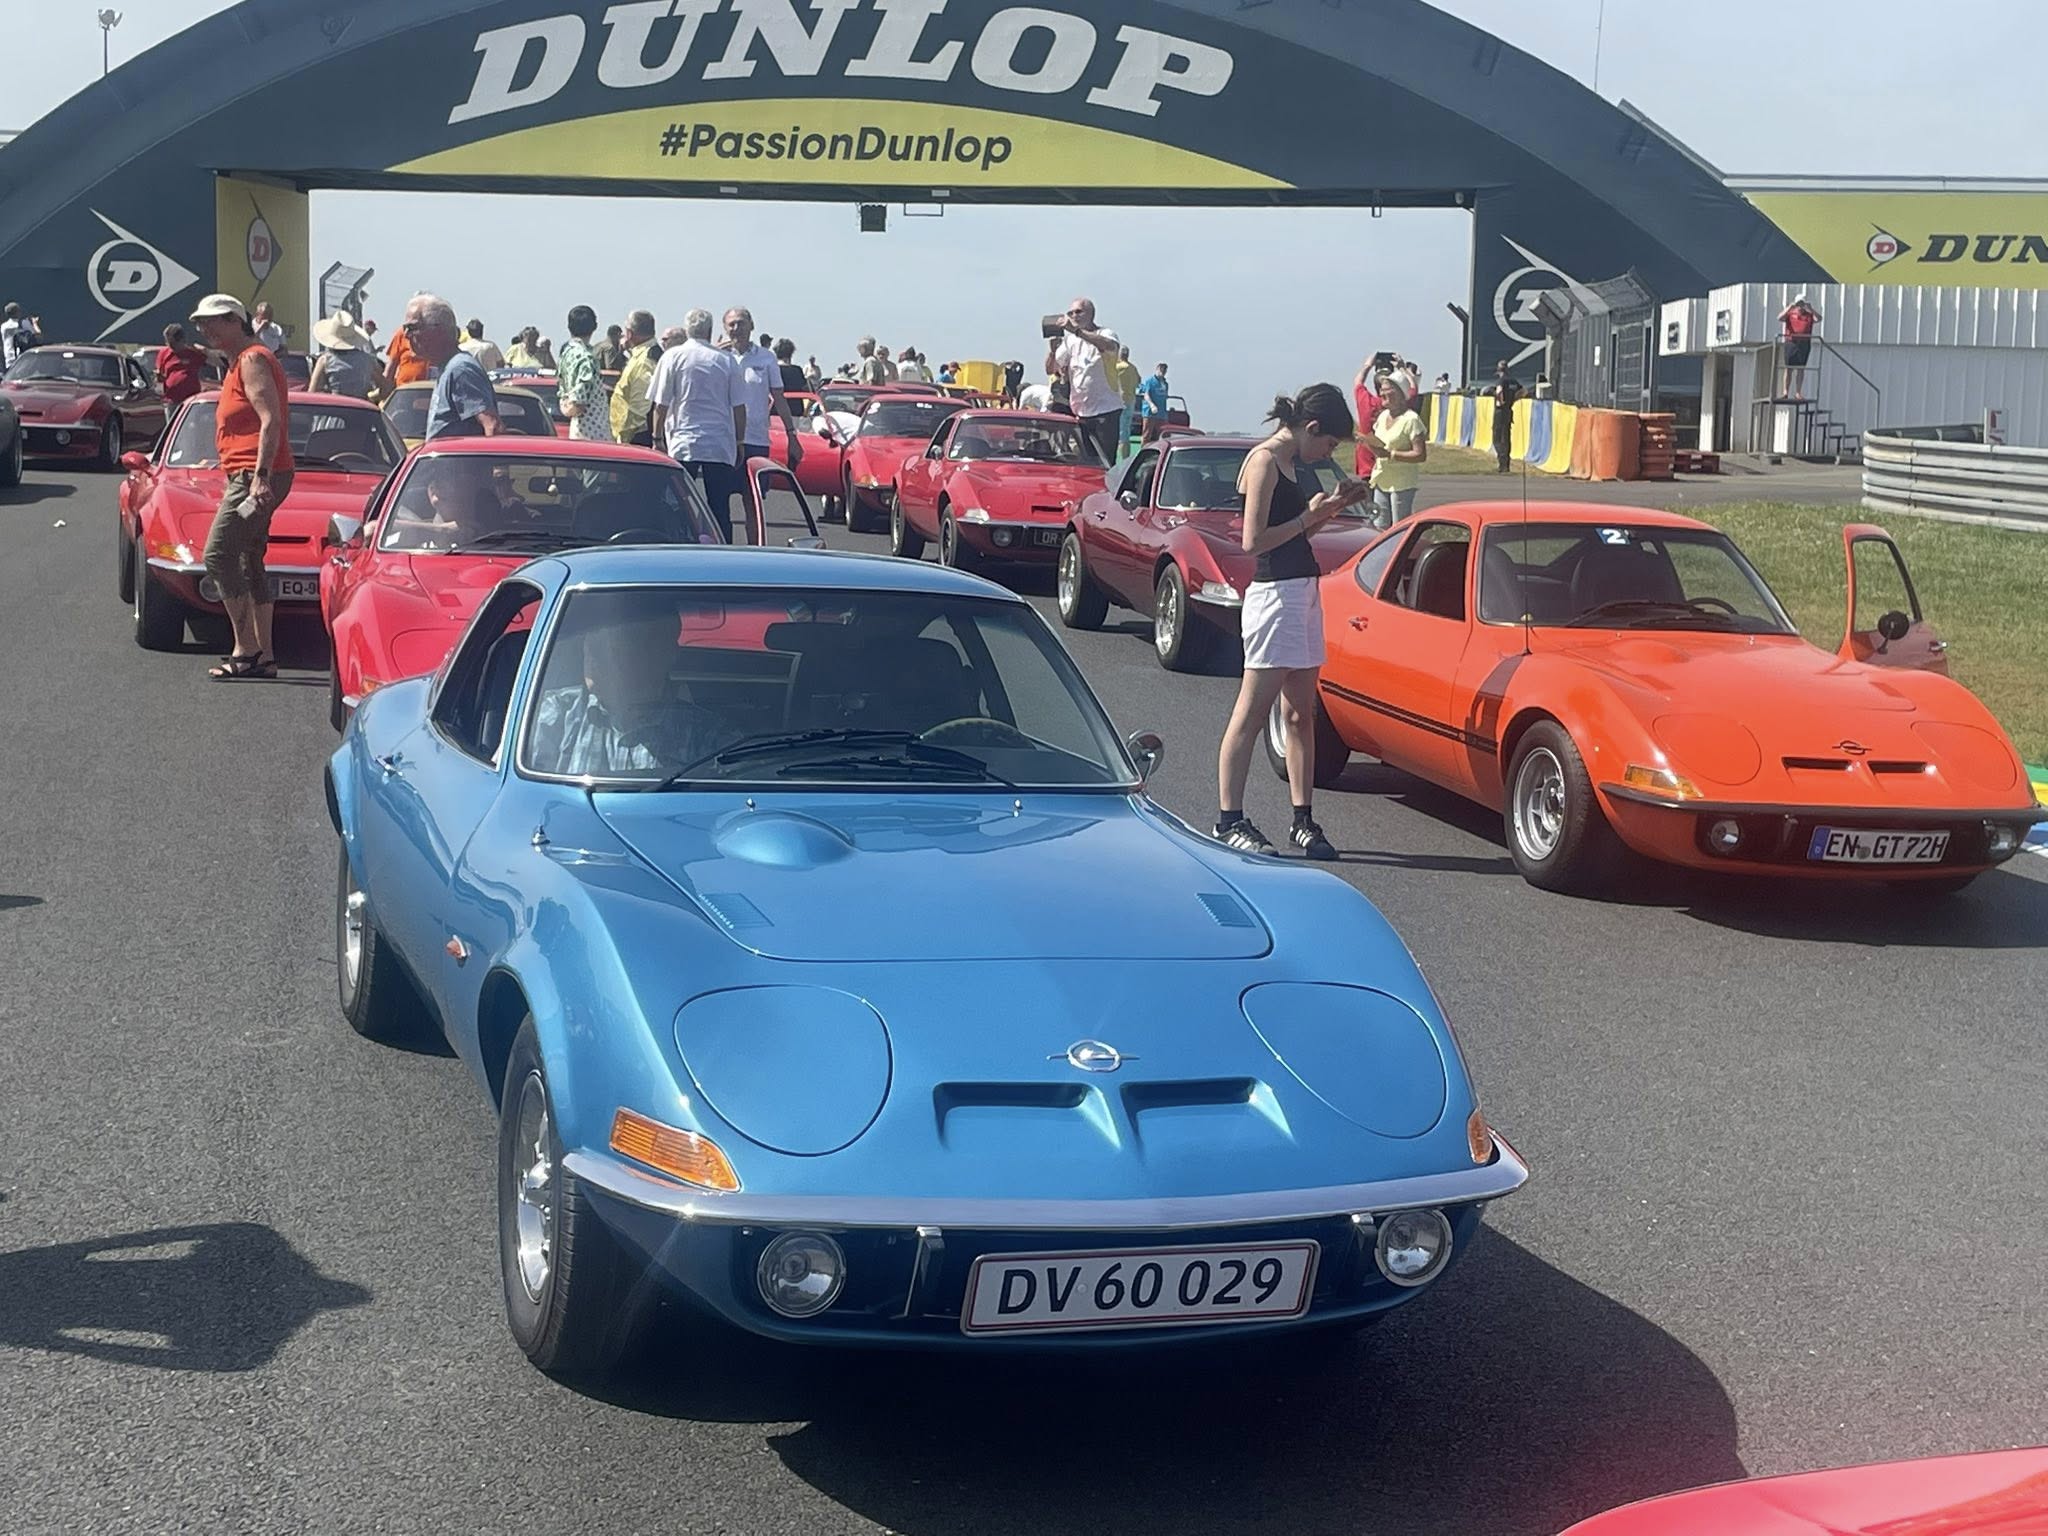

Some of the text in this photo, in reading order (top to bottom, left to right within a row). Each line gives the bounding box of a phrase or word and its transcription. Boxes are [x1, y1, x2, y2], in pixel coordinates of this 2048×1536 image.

[447, 0, 1234, 124] DUNLOP
[660, 124, 1012, 171] #PassionDunlop
[103, 261, 158, 292] D
[282, 581, 320, 595] EQ-9
[998, 1258, 1283, 1314] DV 60 029
